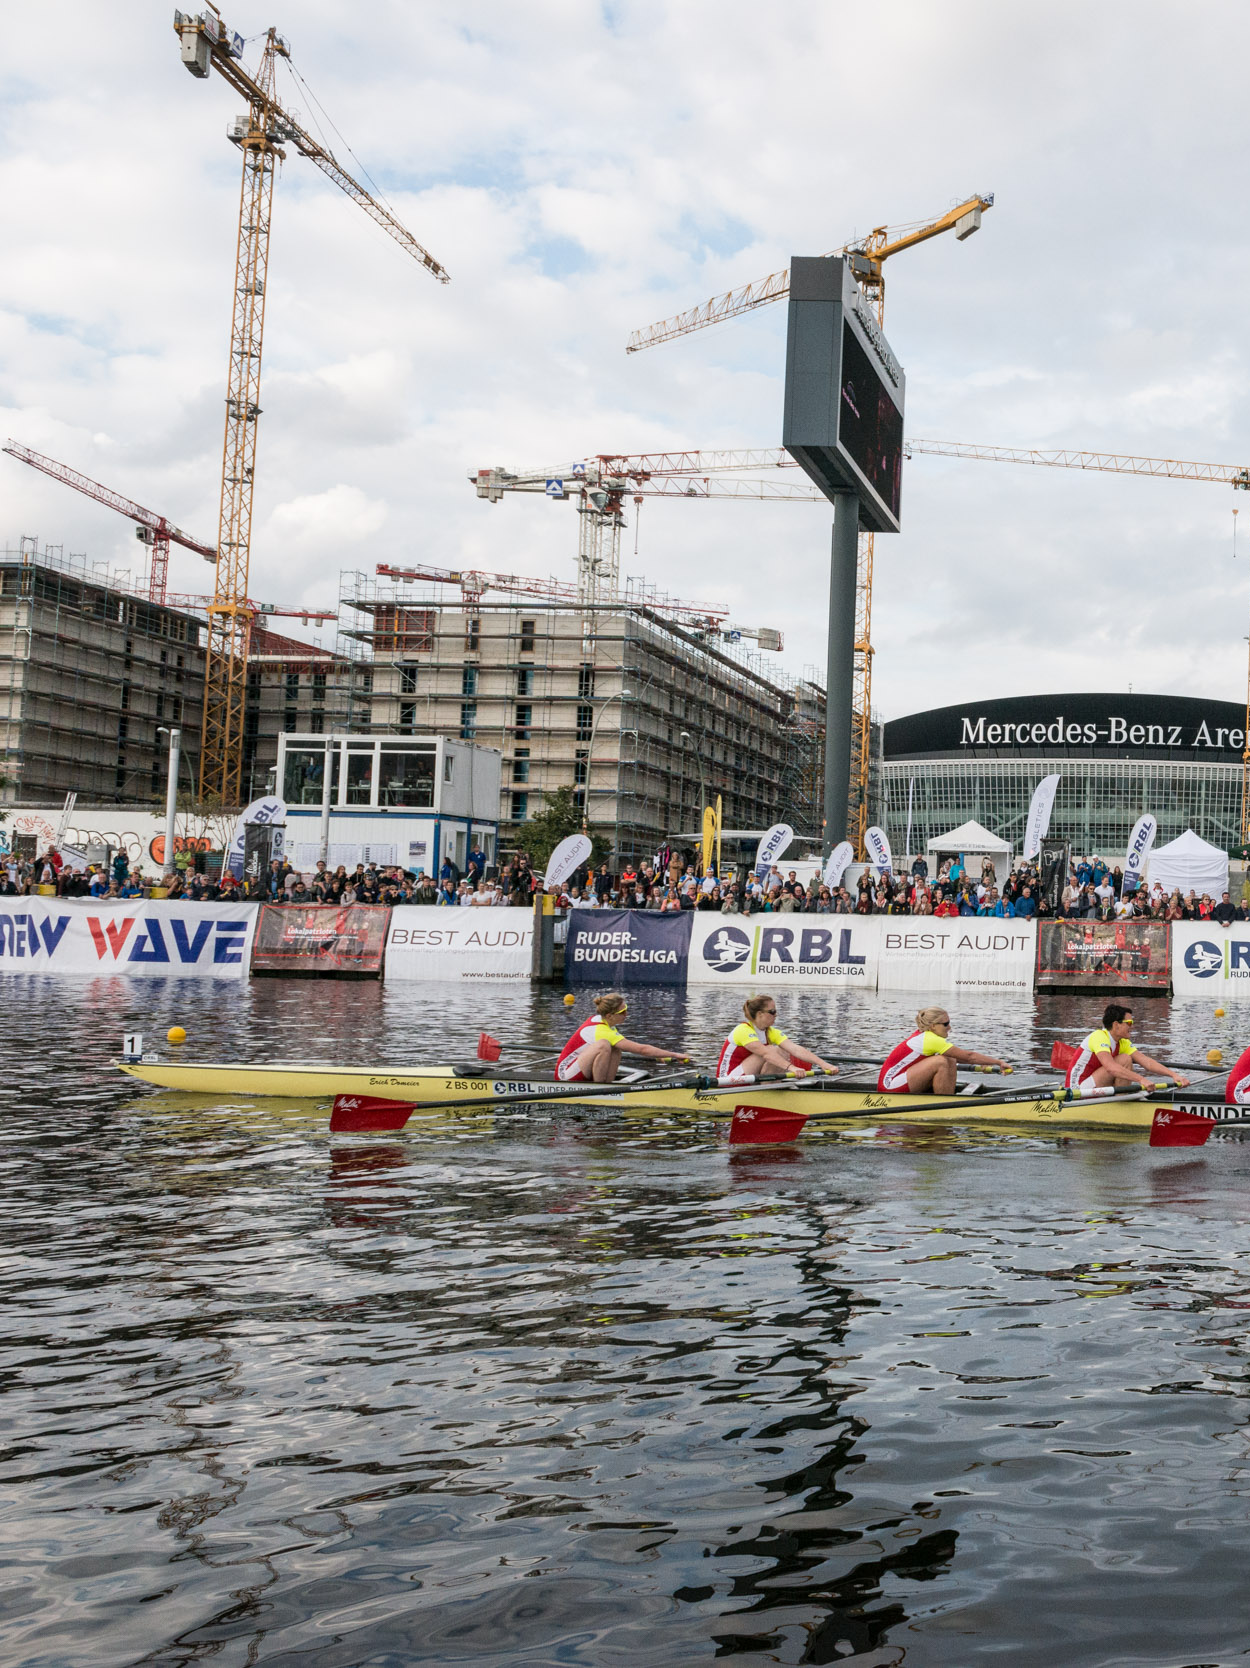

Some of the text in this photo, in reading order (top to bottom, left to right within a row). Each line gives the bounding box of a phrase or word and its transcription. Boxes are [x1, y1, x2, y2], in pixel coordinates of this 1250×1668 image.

[960, 717, 1182, 746] Mercedes-Benz
[249, 804, 280, 824] BL
[767, 829, 786, 852] RBL
[1134, 822, 1152, 854] RBL
[548, 839, 586, 886] BEST AUDIT
[86, 916, 250, 964] WAVE
[391, 929, 460, 946] BEST
[576, 932, 638, 946] RUDER-
[760, 927, 866, 965] RBL
[886, 934, 1031, 952] BEST AUDIT
[1067, 943, 1118, 951] Lokalpatrioten
[574, 948, 678, 966] BUNDESLIGA
[462, 972, 532, 980] www.bestaudit.d
[758, 964, 866, 976] RUDER-BUNDESLIGA
[955, 979, 1028, 988] www.bestaudit.de
[128, 1036, 135, 1054] 1
[370, 1078, 420, 1087] Erich Domeier
[446, 1081, 488, 1091] Z BS 001
[508, 1083, 536, 1094] RBL
[860, 1094, 888, 1108] Melitta
[1030, 1101, 1060, 1114] Melitta
